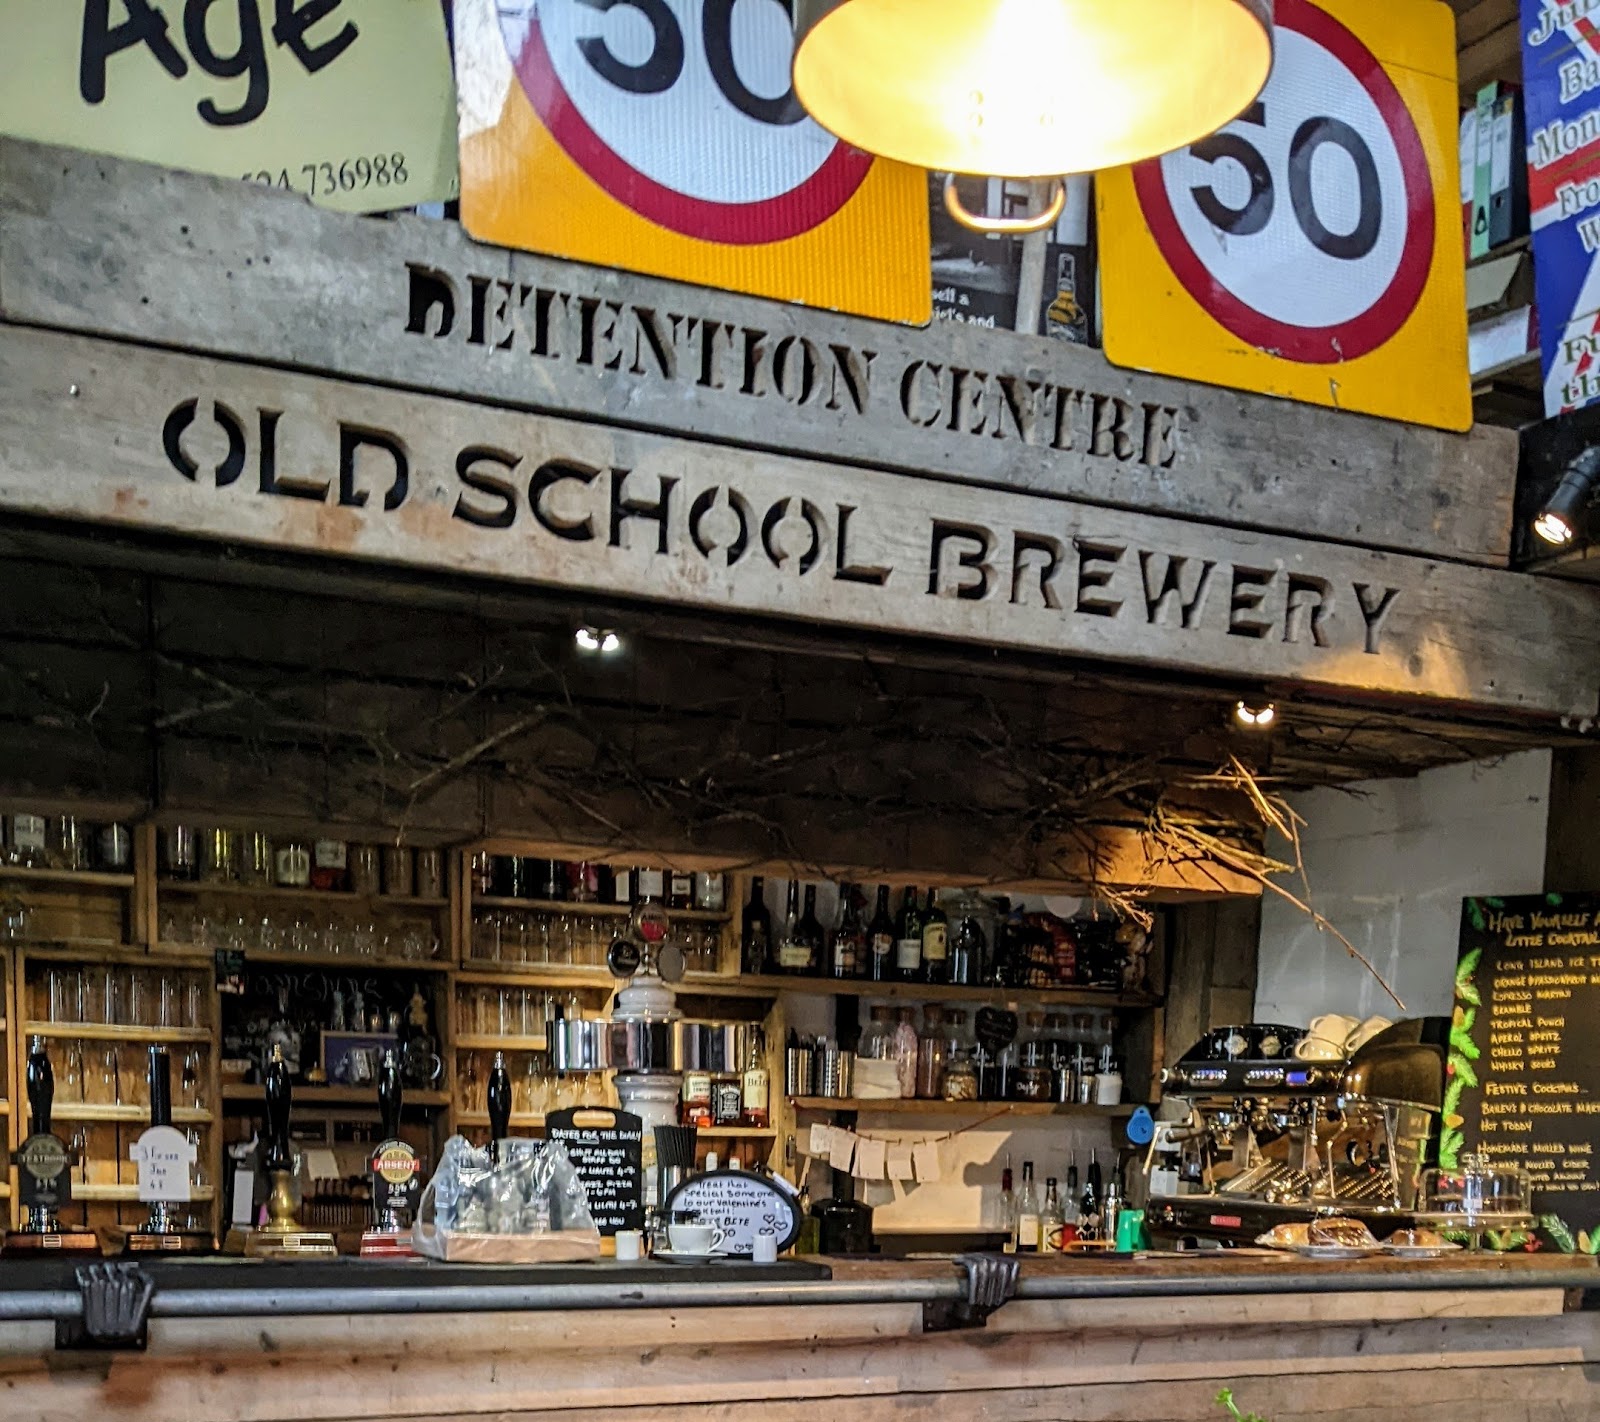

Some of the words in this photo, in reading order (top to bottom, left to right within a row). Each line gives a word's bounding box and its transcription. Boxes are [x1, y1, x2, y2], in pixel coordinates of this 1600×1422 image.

[302, 151, 408, 196] 736988
[1189, 101, 1383, 261] 50
[405, 261, 878, 416] DETENTION
[900, 359, 1179, 469] CENTRE
[162, 397, 410, 513] OLD
[452, 443, 894, 586] SCHOOL
[925, 517, 1402, 655] BREWERY
[1529, 958, 1564, 969] ISLAND
[1569, 956, 1584, 967] ICE
[1490, 1018, 1533, 1029] TROPICAL
[1537, 1015, 1565, 1028] PUNCH
[1491, 1060, 1525, 1072] WHISKY
[1485, 1081, 1528, 1095] FESTIVE
[1528, 1102, 1573, 1113] CHOCOLATE
[1481, 1118, 1498, 1131] HOT
[600, 1131, 617, 1140] THE
[1477, 1141, 1528, 1154] HOMEMADE
[377, 1160, 416, 1170] ABSENT
